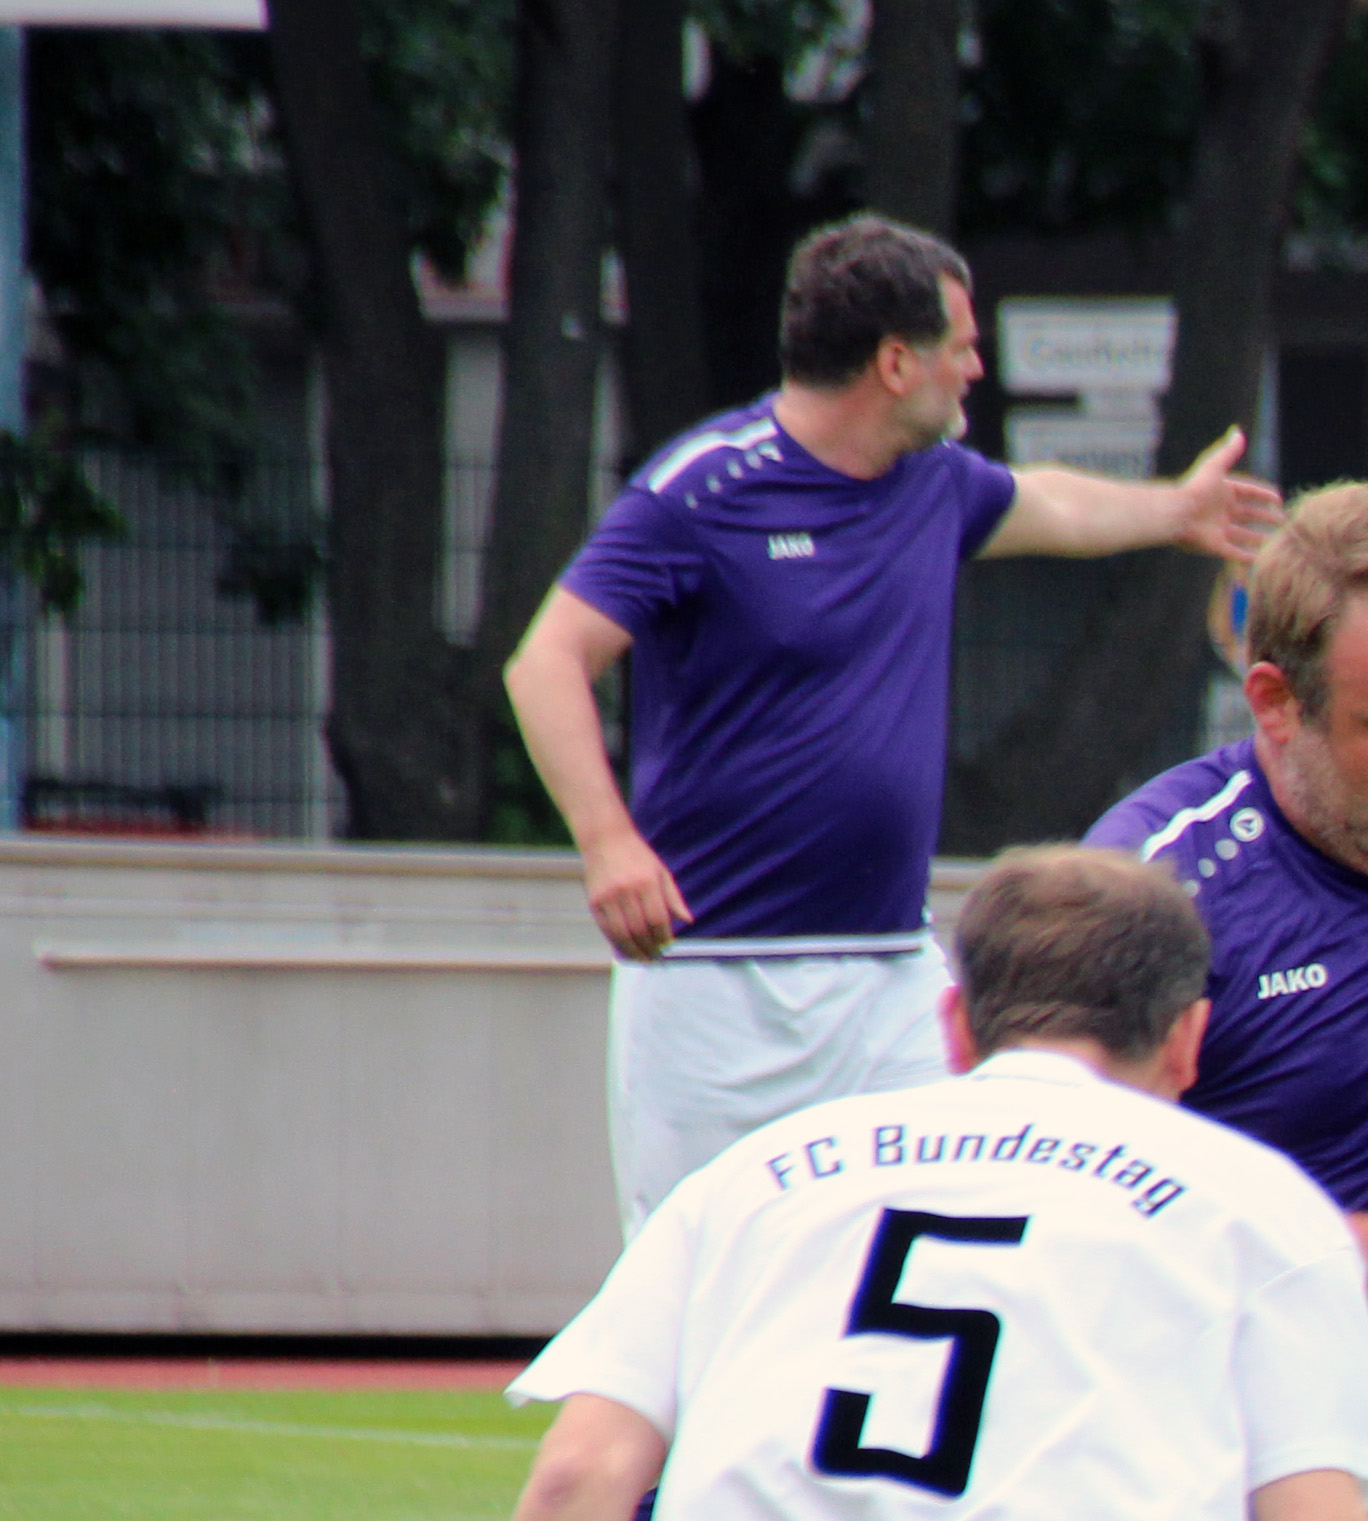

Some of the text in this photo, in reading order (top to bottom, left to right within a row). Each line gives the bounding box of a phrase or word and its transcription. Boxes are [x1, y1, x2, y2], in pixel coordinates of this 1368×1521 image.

[1257, 963, 1328, 999] JAKO
[766, 1124, 1188, 1218] FC Bundestag
[811, 1206, 1030, 1498] 5
